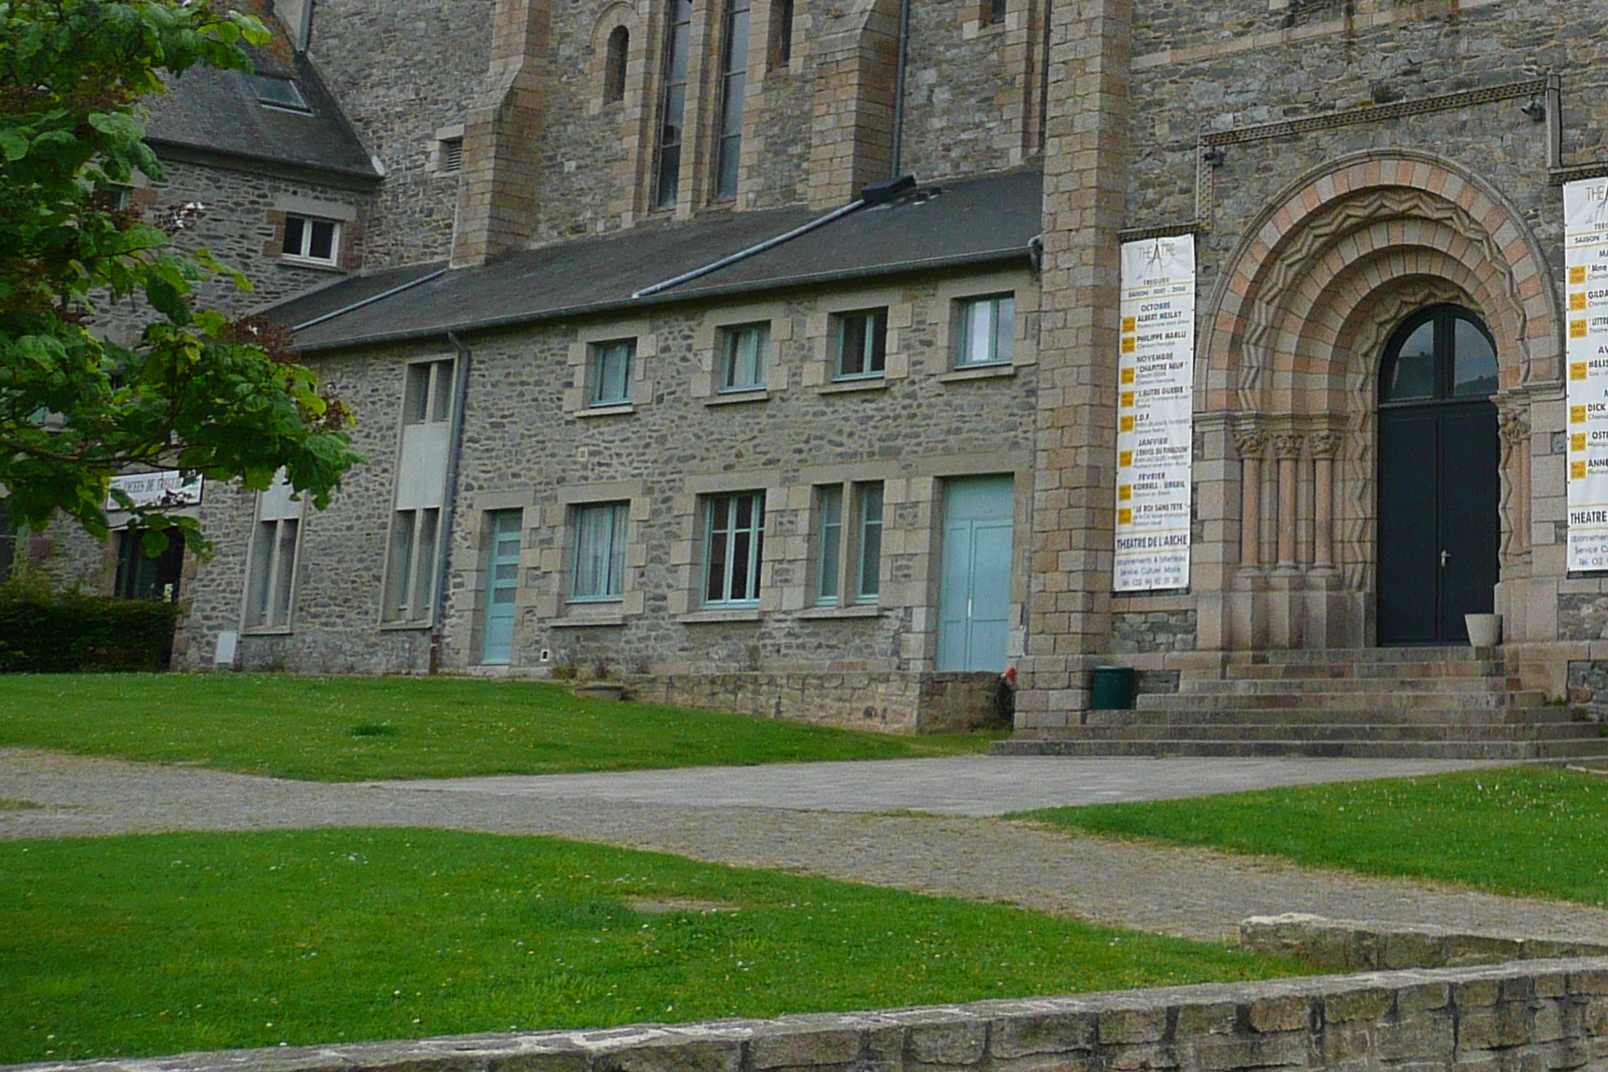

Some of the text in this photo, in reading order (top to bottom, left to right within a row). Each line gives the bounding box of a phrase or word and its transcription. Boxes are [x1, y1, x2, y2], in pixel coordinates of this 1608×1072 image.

[1575, 235, 1599, 244] SAISON
[1141, 302, 1171, 312] OCTOBRE
[1137, 333, 1162, 342] PHILIPPE
[1137, 352, 1173, 362] NOVEMBRE
[1139, 438, 1168, 446] JANVIER
[1588, 459, 1608, 467] ANNE
[1571, 511, 1607, 524] THEATRE
[1575, 546, 1597, 554] Service
